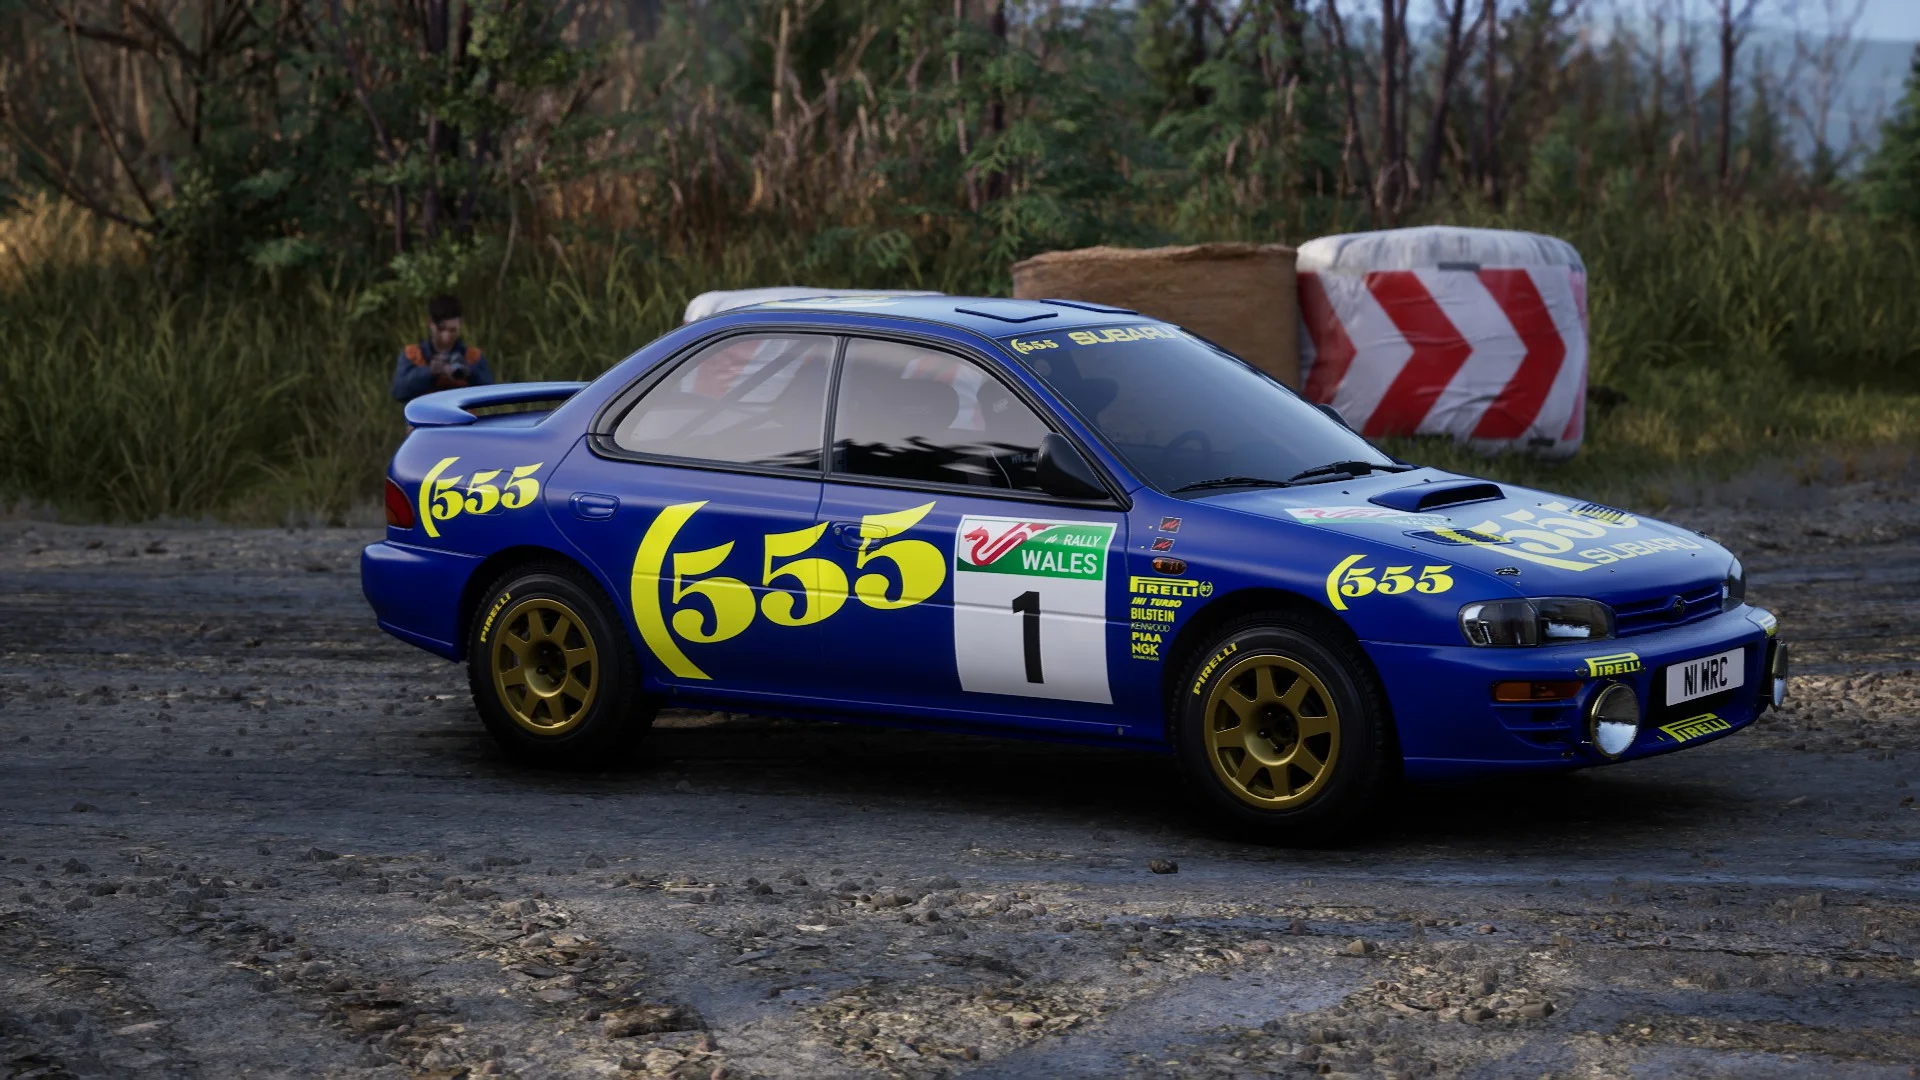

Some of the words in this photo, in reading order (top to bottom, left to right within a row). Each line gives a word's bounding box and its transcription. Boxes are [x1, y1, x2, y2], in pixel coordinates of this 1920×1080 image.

[1068, 327, 1177, 346] SUBARU
[1063, 534, 1102, 548] RALLY
[1578, 536, 1705, 565] SUBARU
[1021, 549, 1098, 574] WALES
[1130, 575, 1199, 597] PIRELLI
[1131, 597, 1148, 606] IHI
[1150, 598, 1183, 608] TURBO
[480, 592, 512, 643] PIRELLI
[1130, 607, 1175, 622] BILSTEIN
[1011, 590, 1045, 684] 1
[1130, 622, 1171, 633] KENWOOD
[1131, 631, 1162, 643] PIAA
[1131, 643, 1160, 656] NGK
[1193, 642, 1237, 695] PIRELLI
[1584, 652, 1641, 677] PIRELLI
[1700, 656, 1728, 693] WRC
[1658, 713, 1732, 743] PIRELLI
